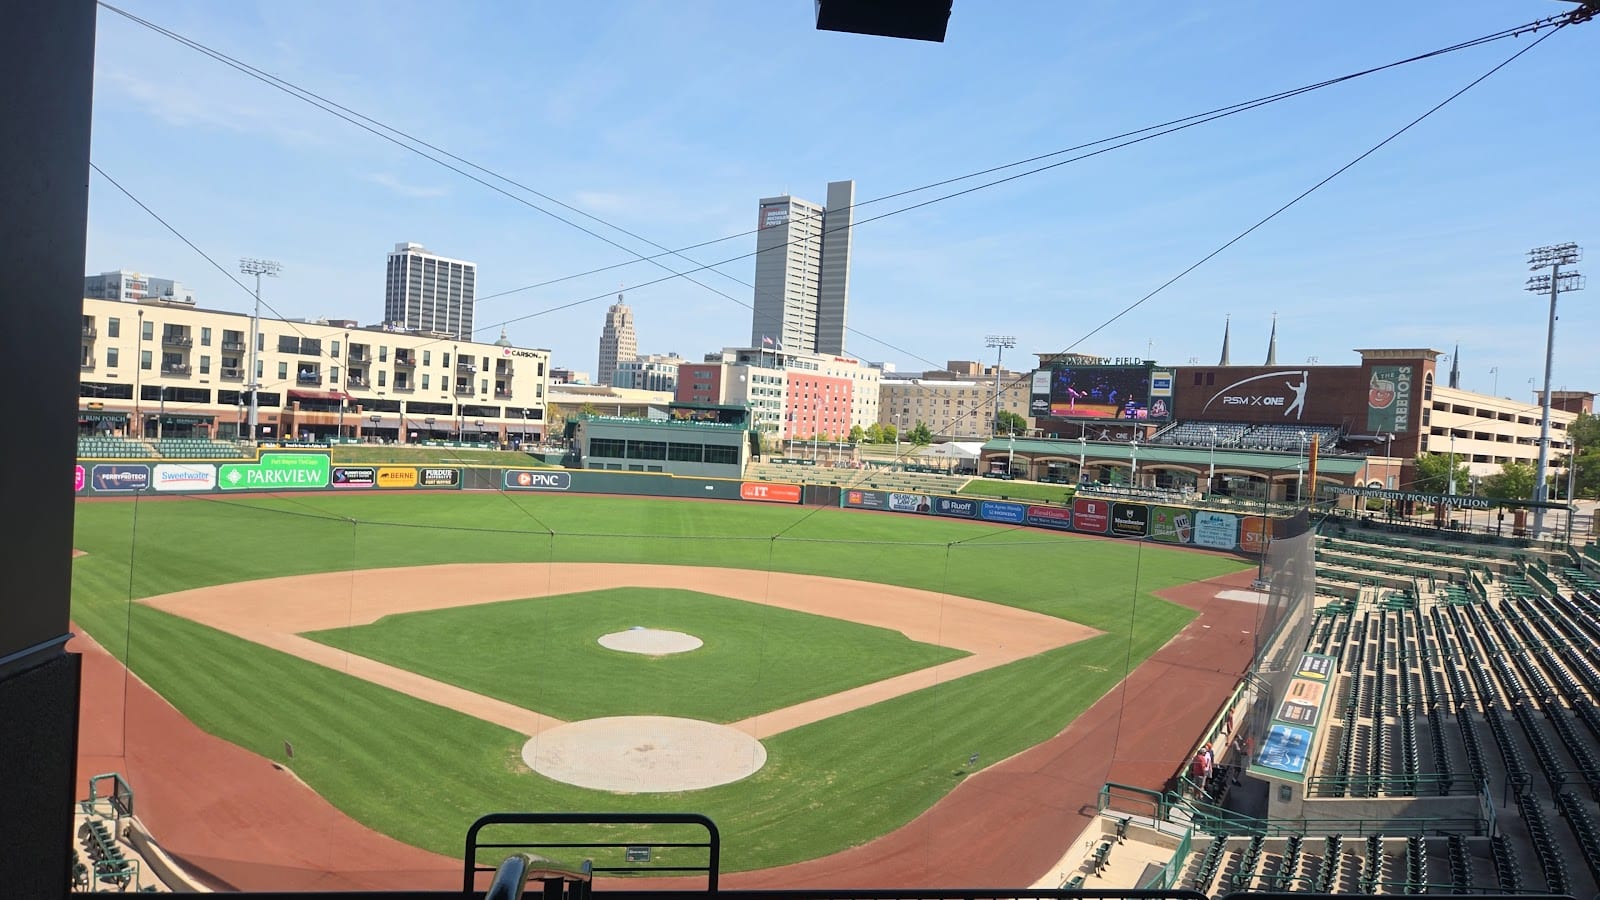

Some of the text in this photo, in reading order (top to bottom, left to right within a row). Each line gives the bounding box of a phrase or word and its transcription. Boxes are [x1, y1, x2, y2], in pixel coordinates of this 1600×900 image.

[511, 350, 538, 358] CARSON
[1065, 357, 1140, 366] PARKVIEW FIELD
[1263, 396, 1285, 406] ONE
[1395, 366, 1411, 432] TREETOPS
[102, 415, 126, 423] PORCH
[161, 471, 210, 481] Sweetwater
[246, 468, 322, 483] PARKVIEW
[532, 474, 559, 486] PNC
[1323, 486, 1490, 508] HUNTINGTON UNIVERSITY PICNIC PAVILION
[951, 501, 972, 511] Ruoff
[1114, 517, 1145, 526] Manchester
